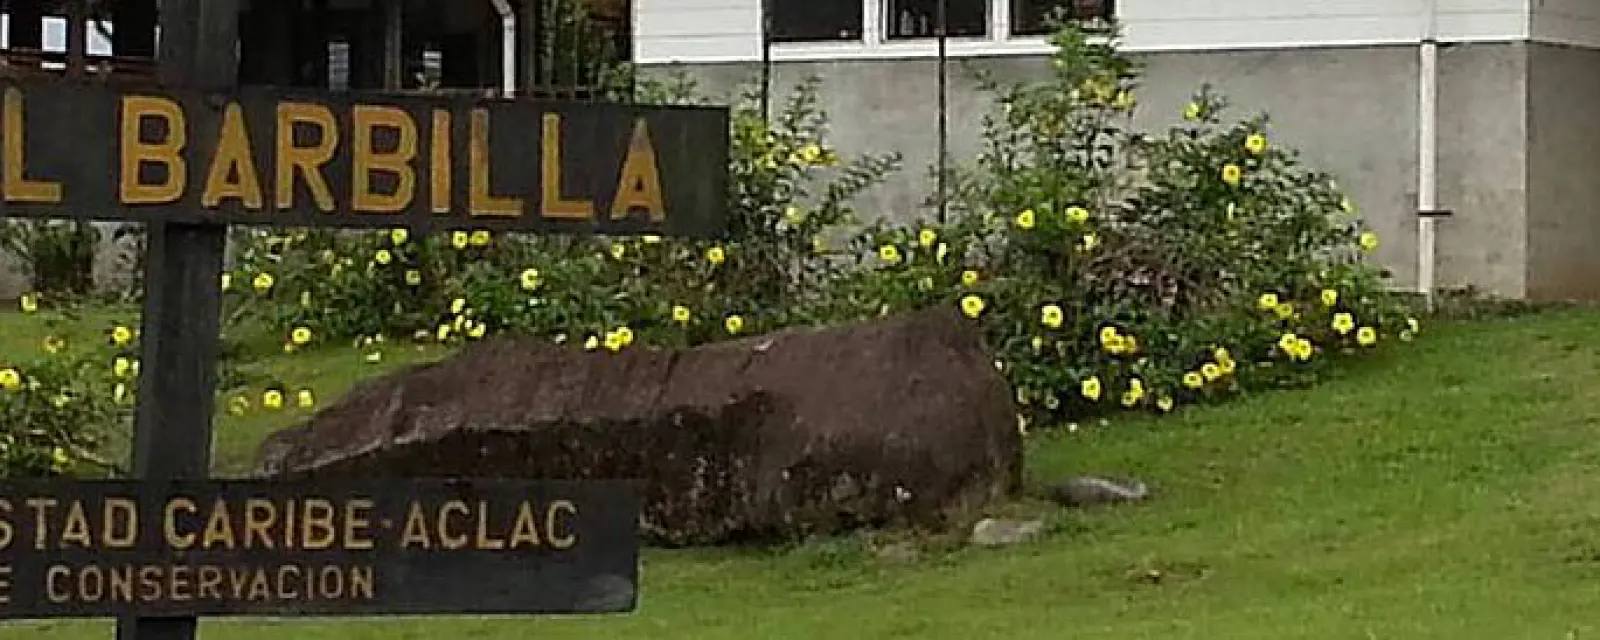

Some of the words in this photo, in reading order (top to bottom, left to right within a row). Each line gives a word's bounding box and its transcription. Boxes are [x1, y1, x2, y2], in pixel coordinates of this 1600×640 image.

[4, 87, 61, 202] L
[121, 96, 666, 221] BARBILLA
[47, 565, 375, 601] CONSERVACION
